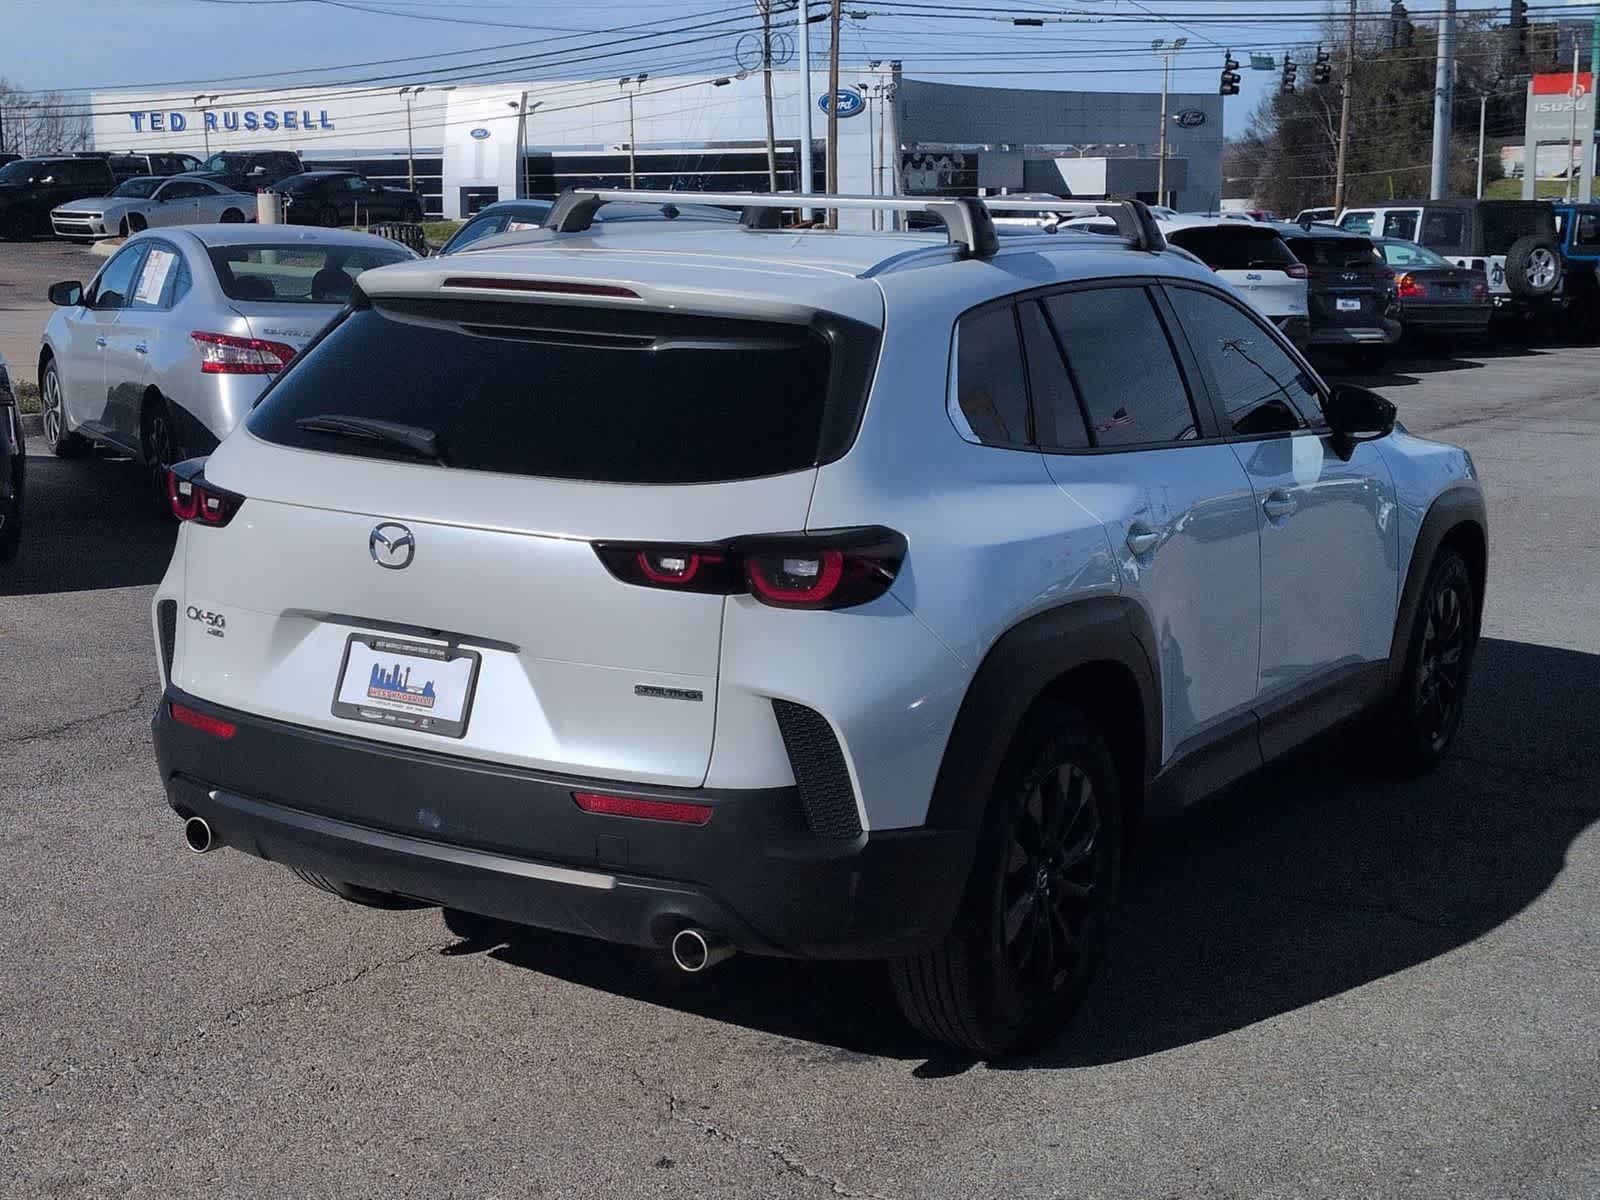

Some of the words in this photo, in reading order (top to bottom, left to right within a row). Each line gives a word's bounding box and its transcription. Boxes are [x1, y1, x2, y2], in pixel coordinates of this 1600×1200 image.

[1535, 101, 1586, 113] ISUZU
[130, 111, 188, 132] TED
[204, 110, 336, 132] RUSSELL
[186, 605, 226, 629] CX-50
